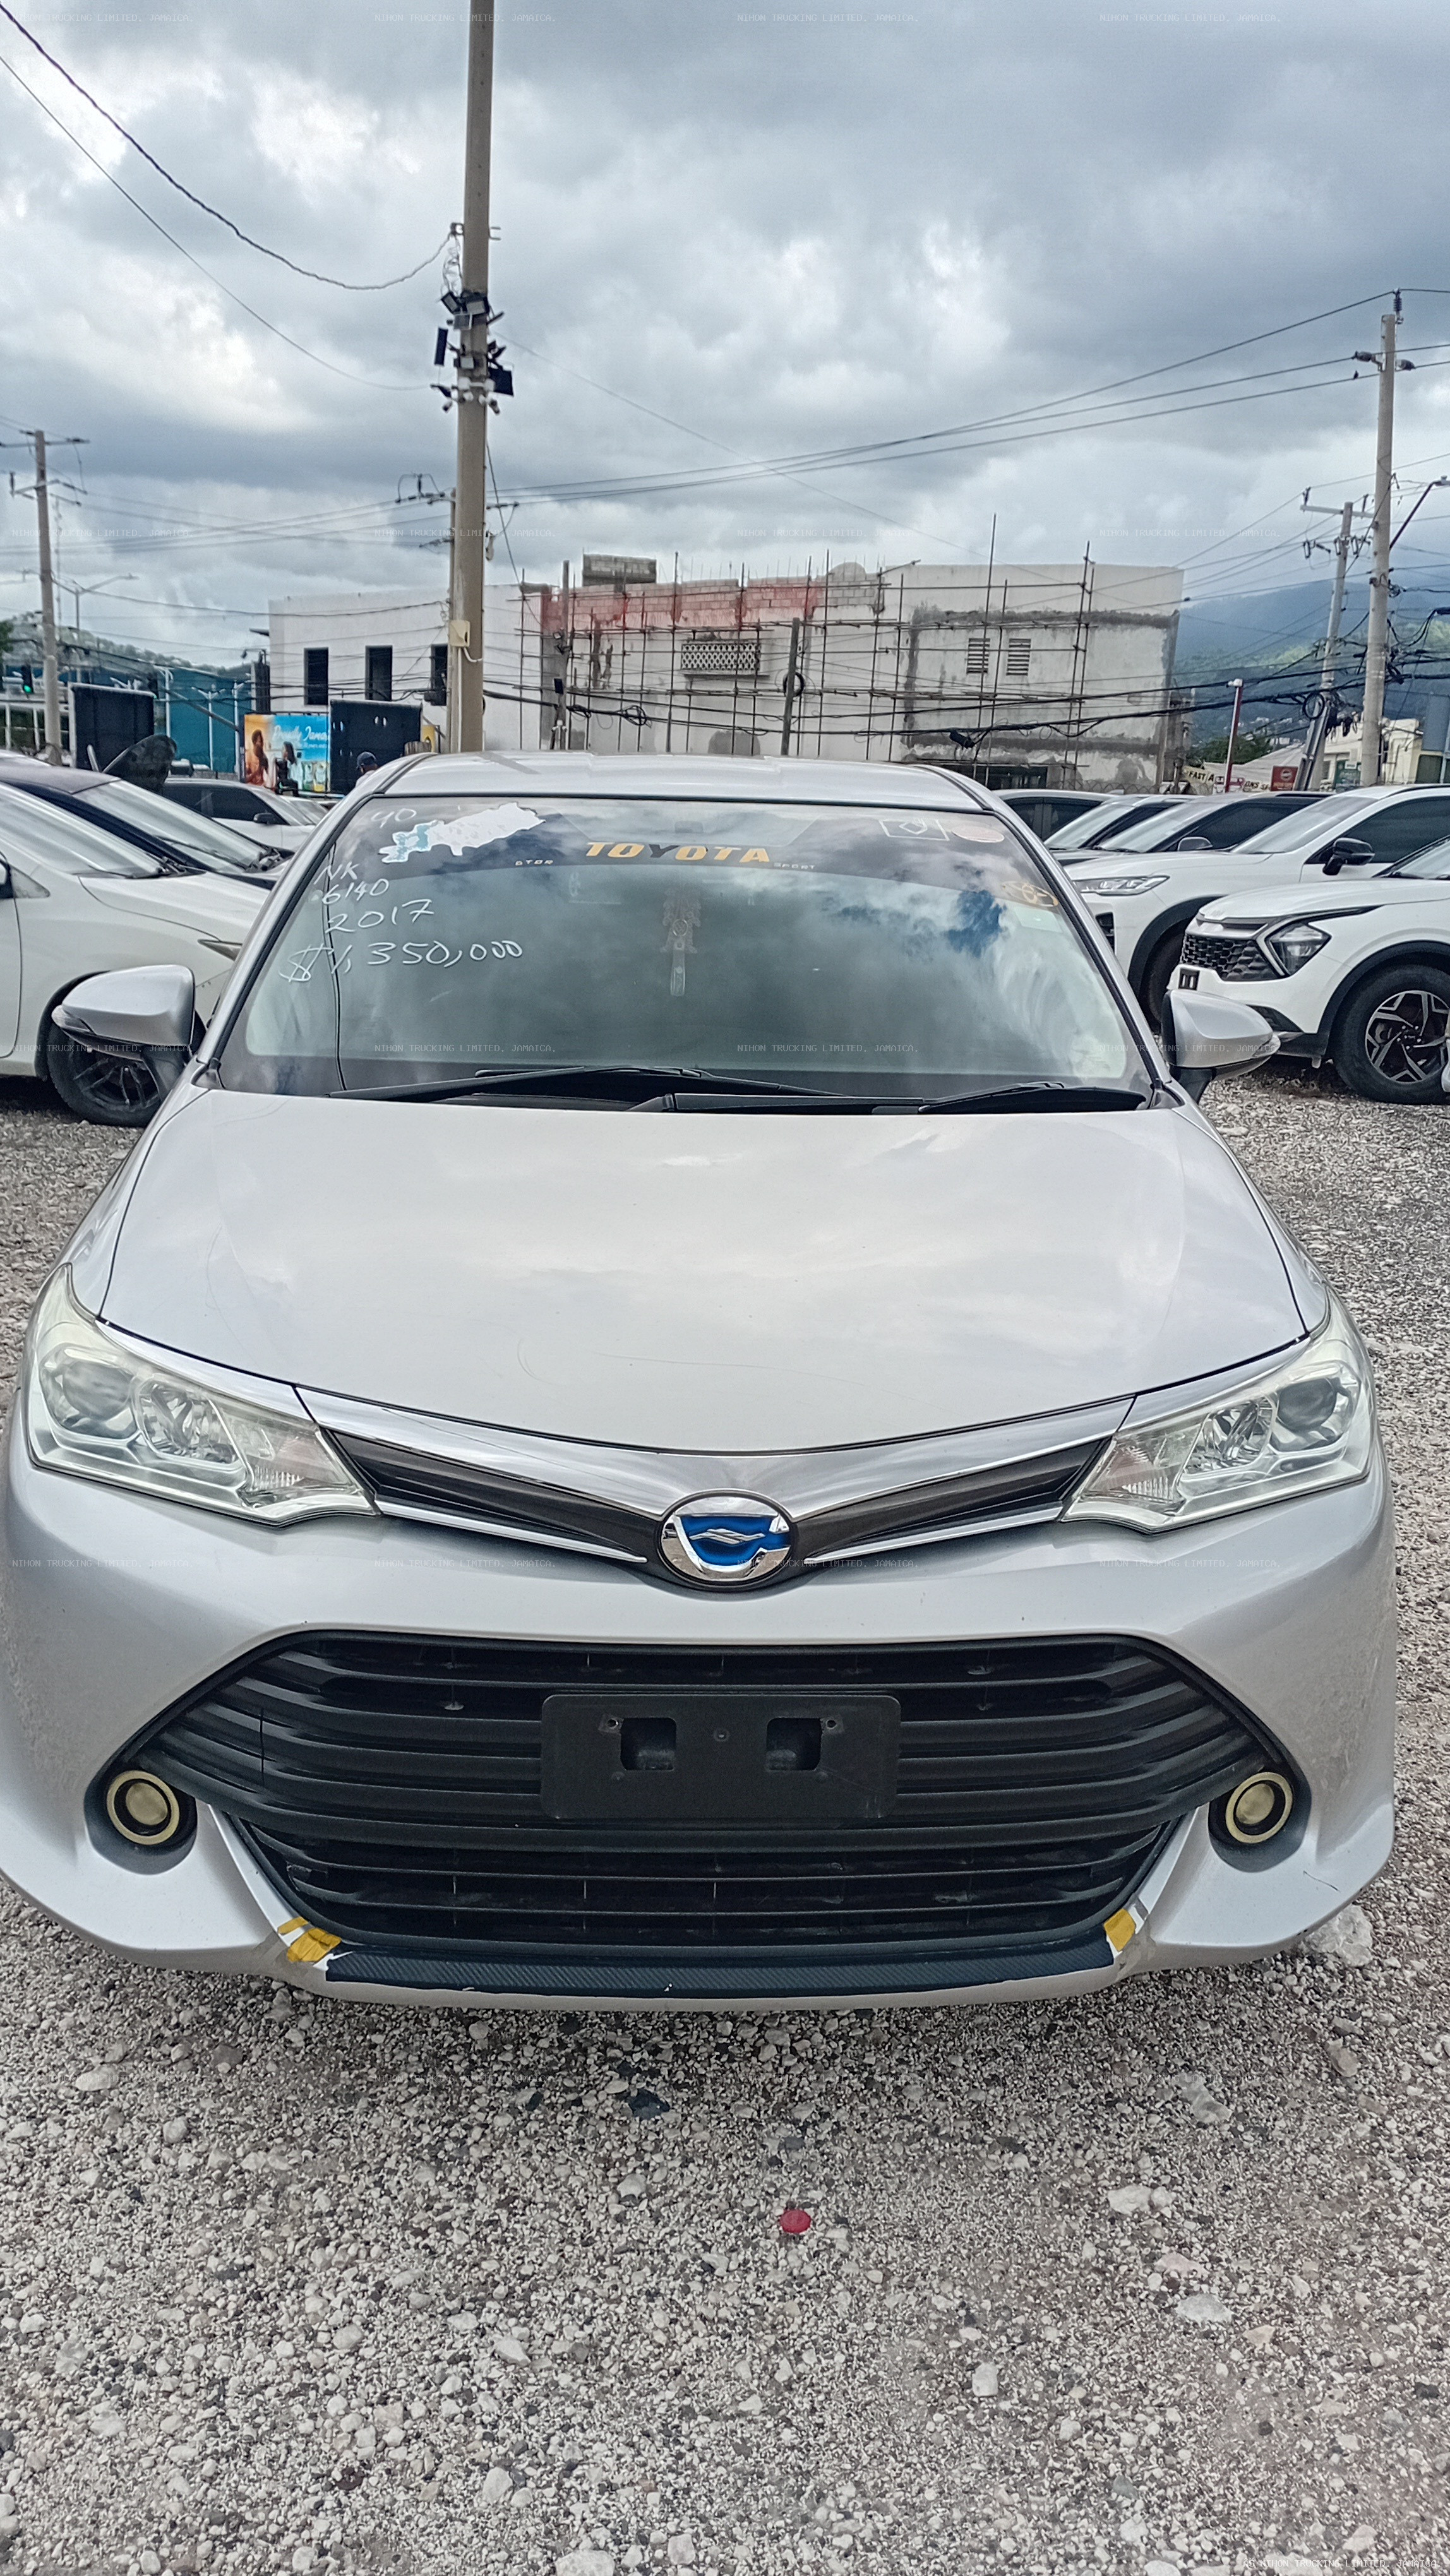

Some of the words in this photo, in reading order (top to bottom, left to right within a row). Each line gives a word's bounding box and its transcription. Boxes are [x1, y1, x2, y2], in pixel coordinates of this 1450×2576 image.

[586, 842, 770, 862] TOYOTA
[774, 862, 816, 870] SPORT
[321, 878, 389, 905] 6140
[325, 898, 434, 934] 2017
